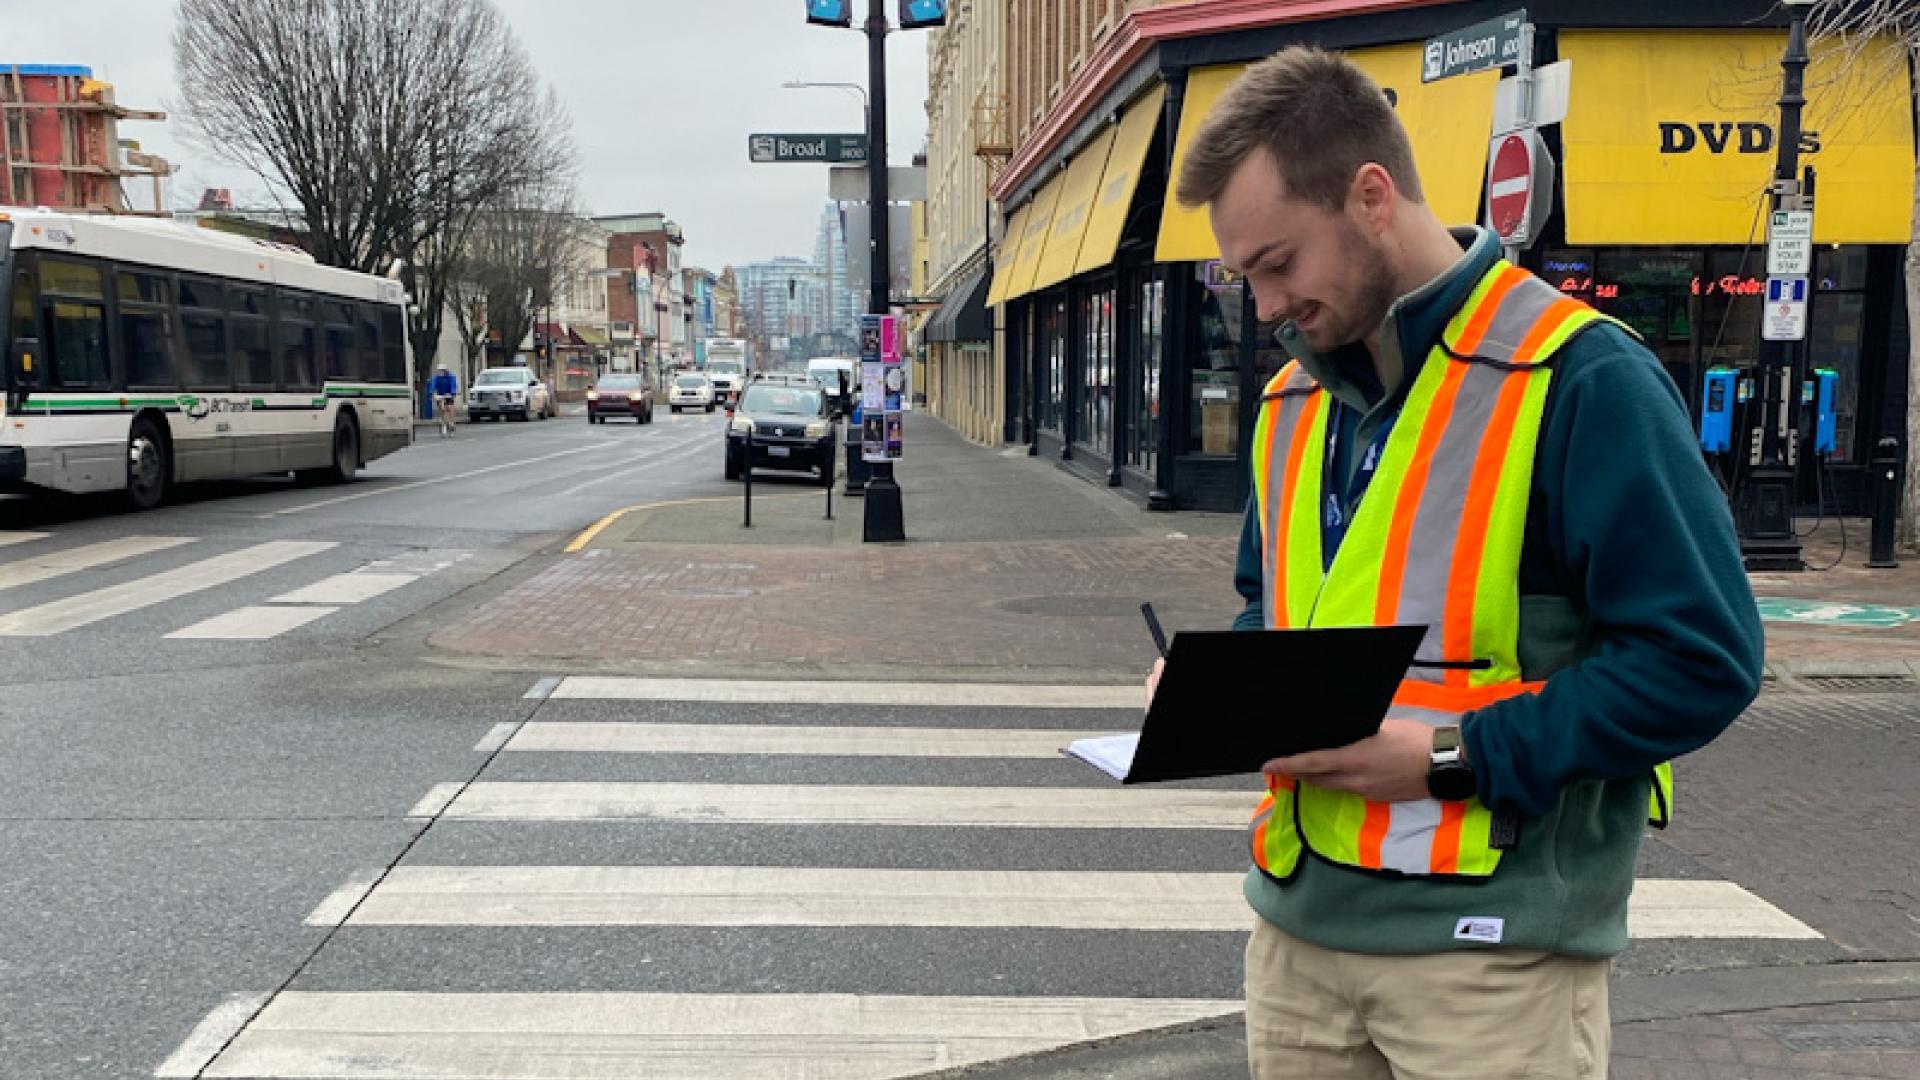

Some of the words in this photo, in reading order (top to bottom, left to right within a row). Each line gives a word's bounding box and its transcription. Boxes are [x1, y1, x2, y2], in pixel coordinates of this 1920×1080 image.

[1445, 36, 1496, 73] Johnson
[779, 138, 826, 156] Broad
[1658, 121, 1820, 154] DVDs
